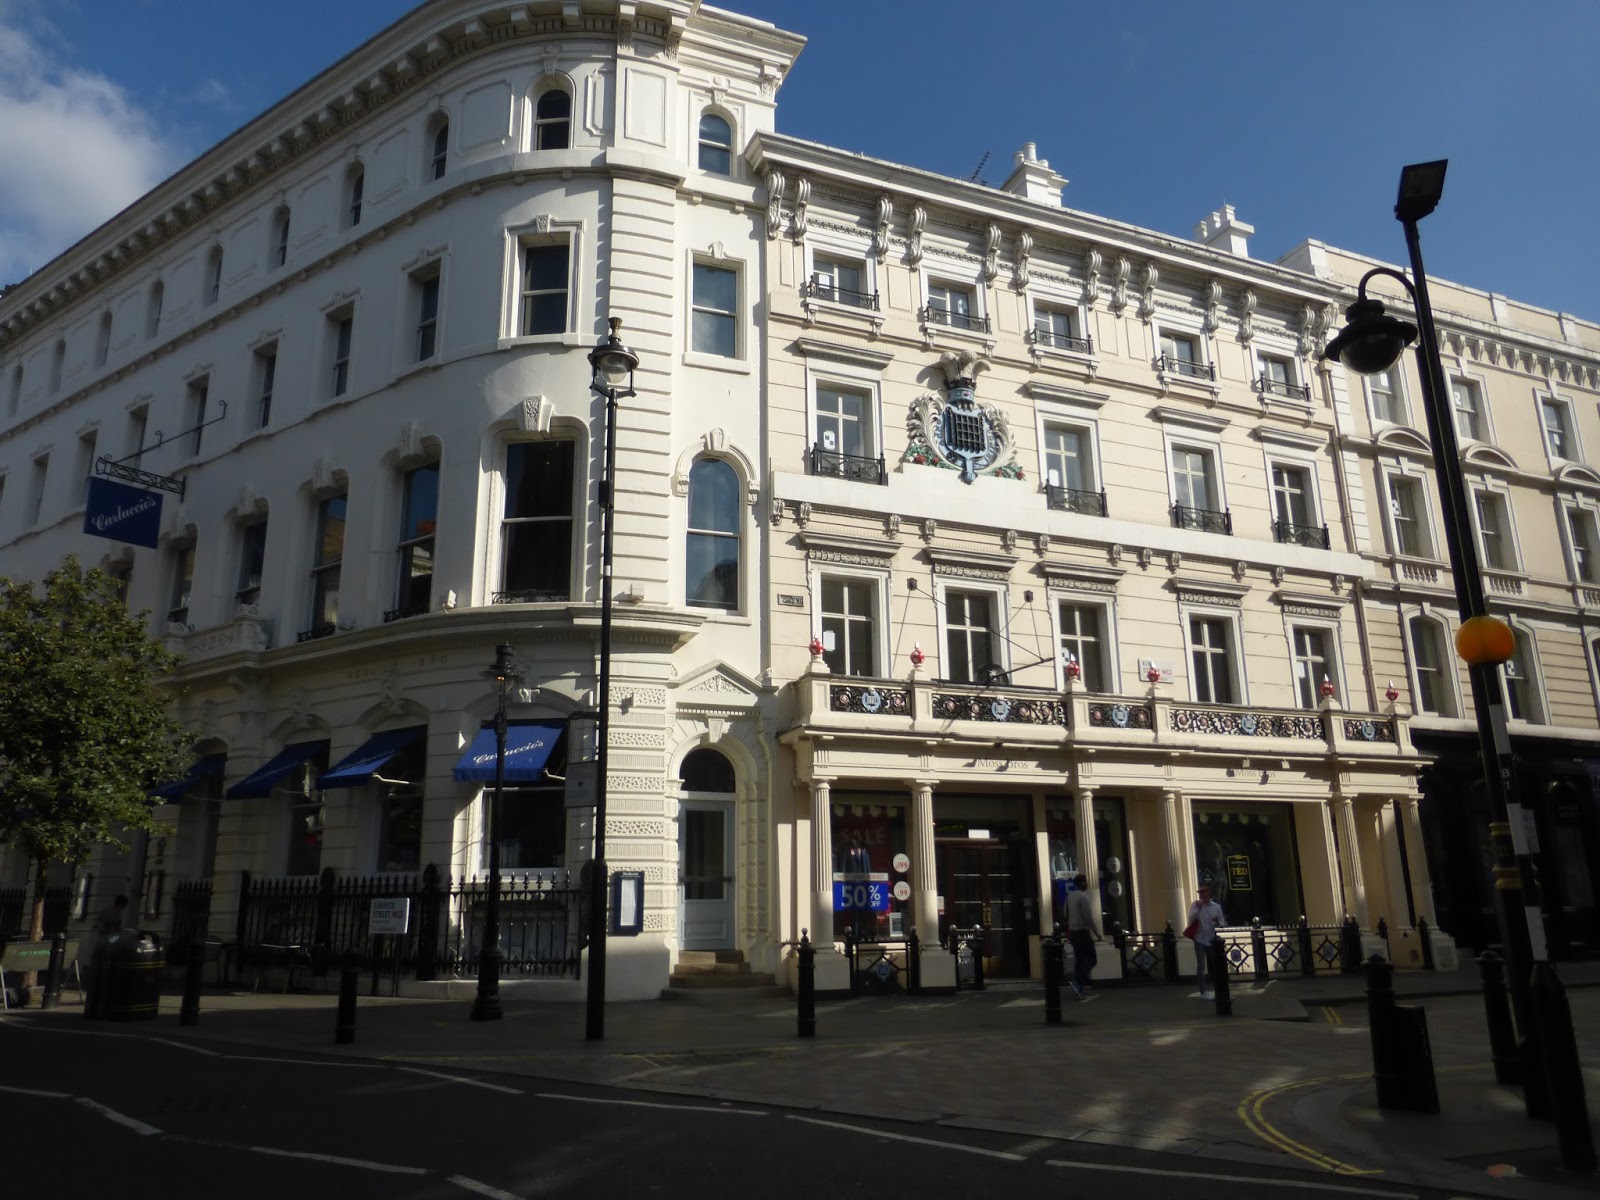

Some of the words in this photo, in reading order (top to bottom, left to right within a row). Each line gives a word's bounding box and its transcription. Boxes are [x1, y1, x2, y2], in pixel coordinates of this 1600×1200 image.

[92, 496, 156, 531] Carluccio's
[977, 759, 1002, 767] Moss
[1236, 769, 1256, 777] Moss
[839, 826, 886, 845] SALE
[868, 900, 881, 908] OFF
